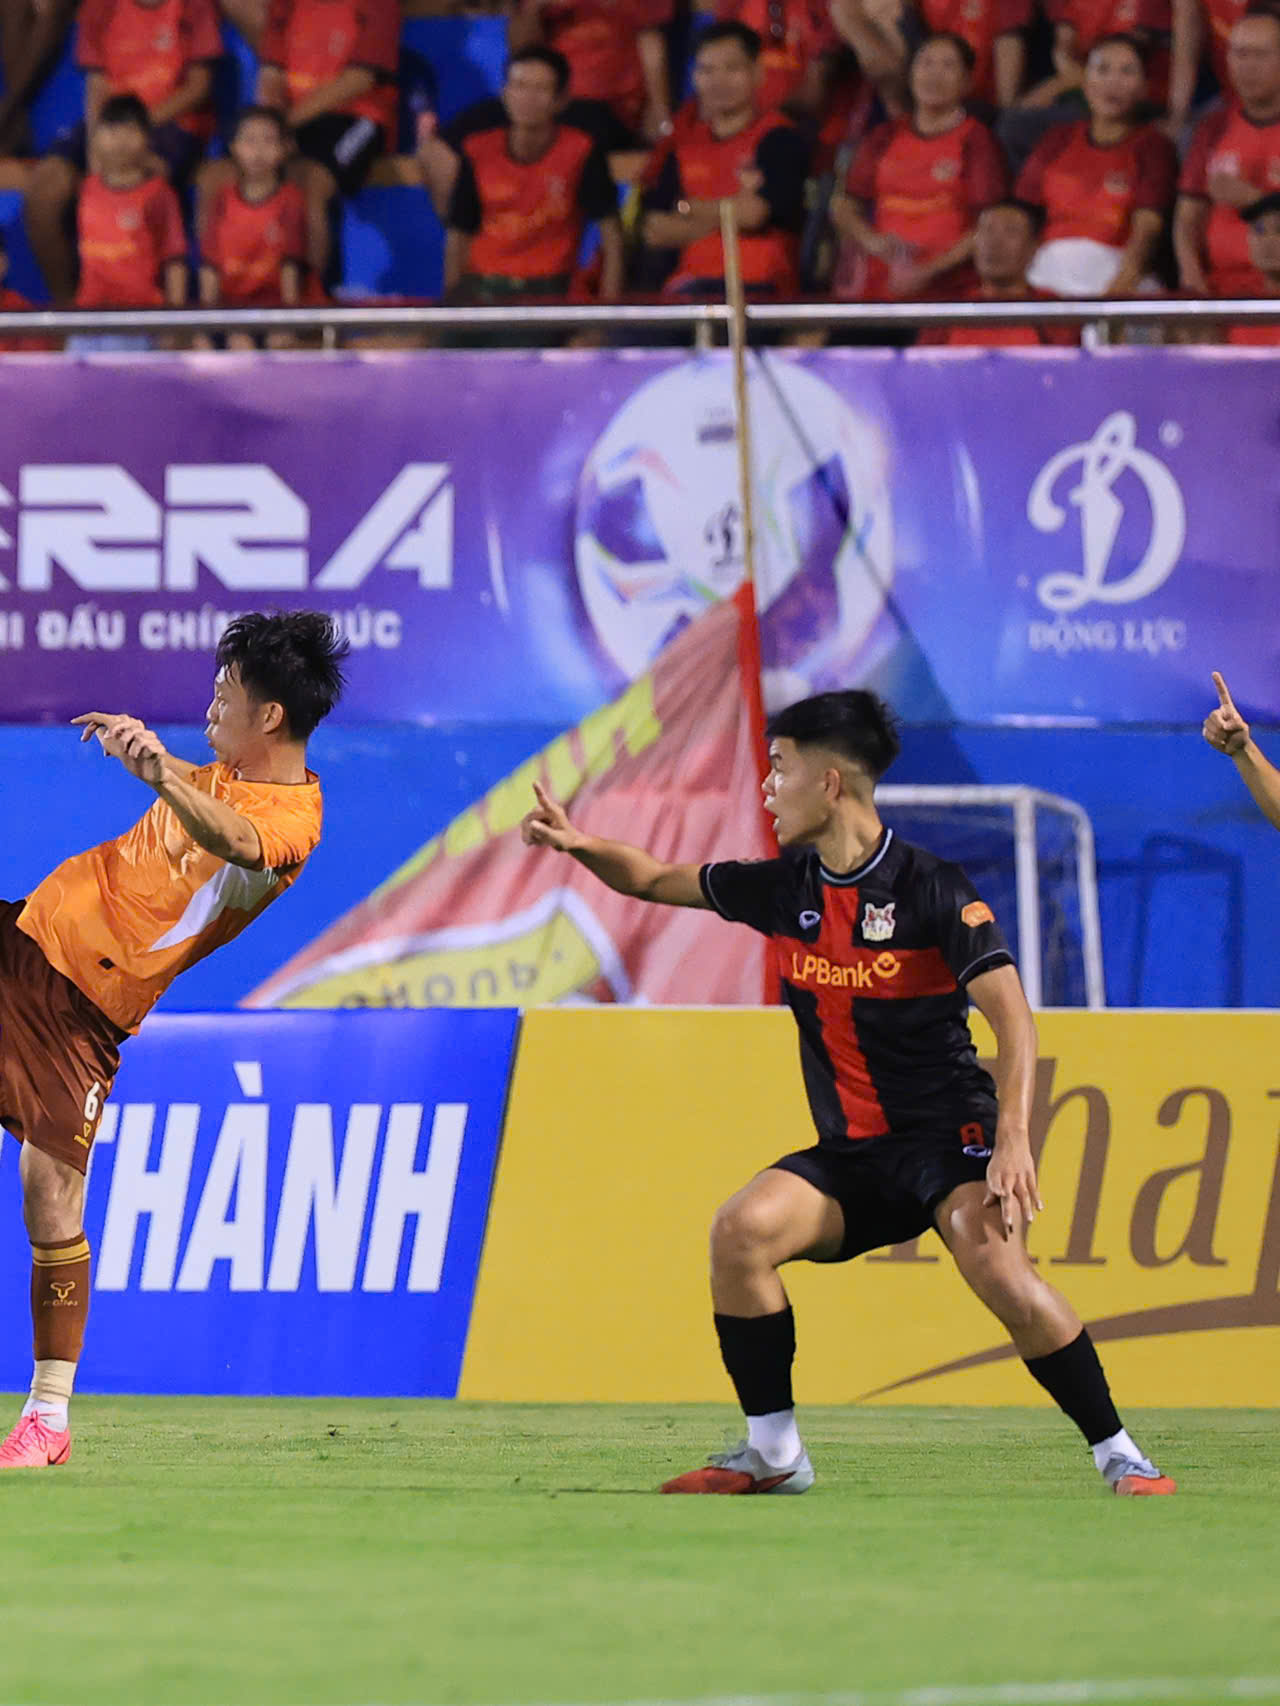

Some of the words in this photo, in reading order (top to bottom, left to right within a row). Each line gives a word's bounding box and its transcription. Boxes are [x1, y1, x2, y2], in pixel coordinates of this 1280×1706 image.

[139, 603, 246, 649] CHÍ
[792, 951, 873, 988] LPBank
[84, 1081, 100, 1121] 6
